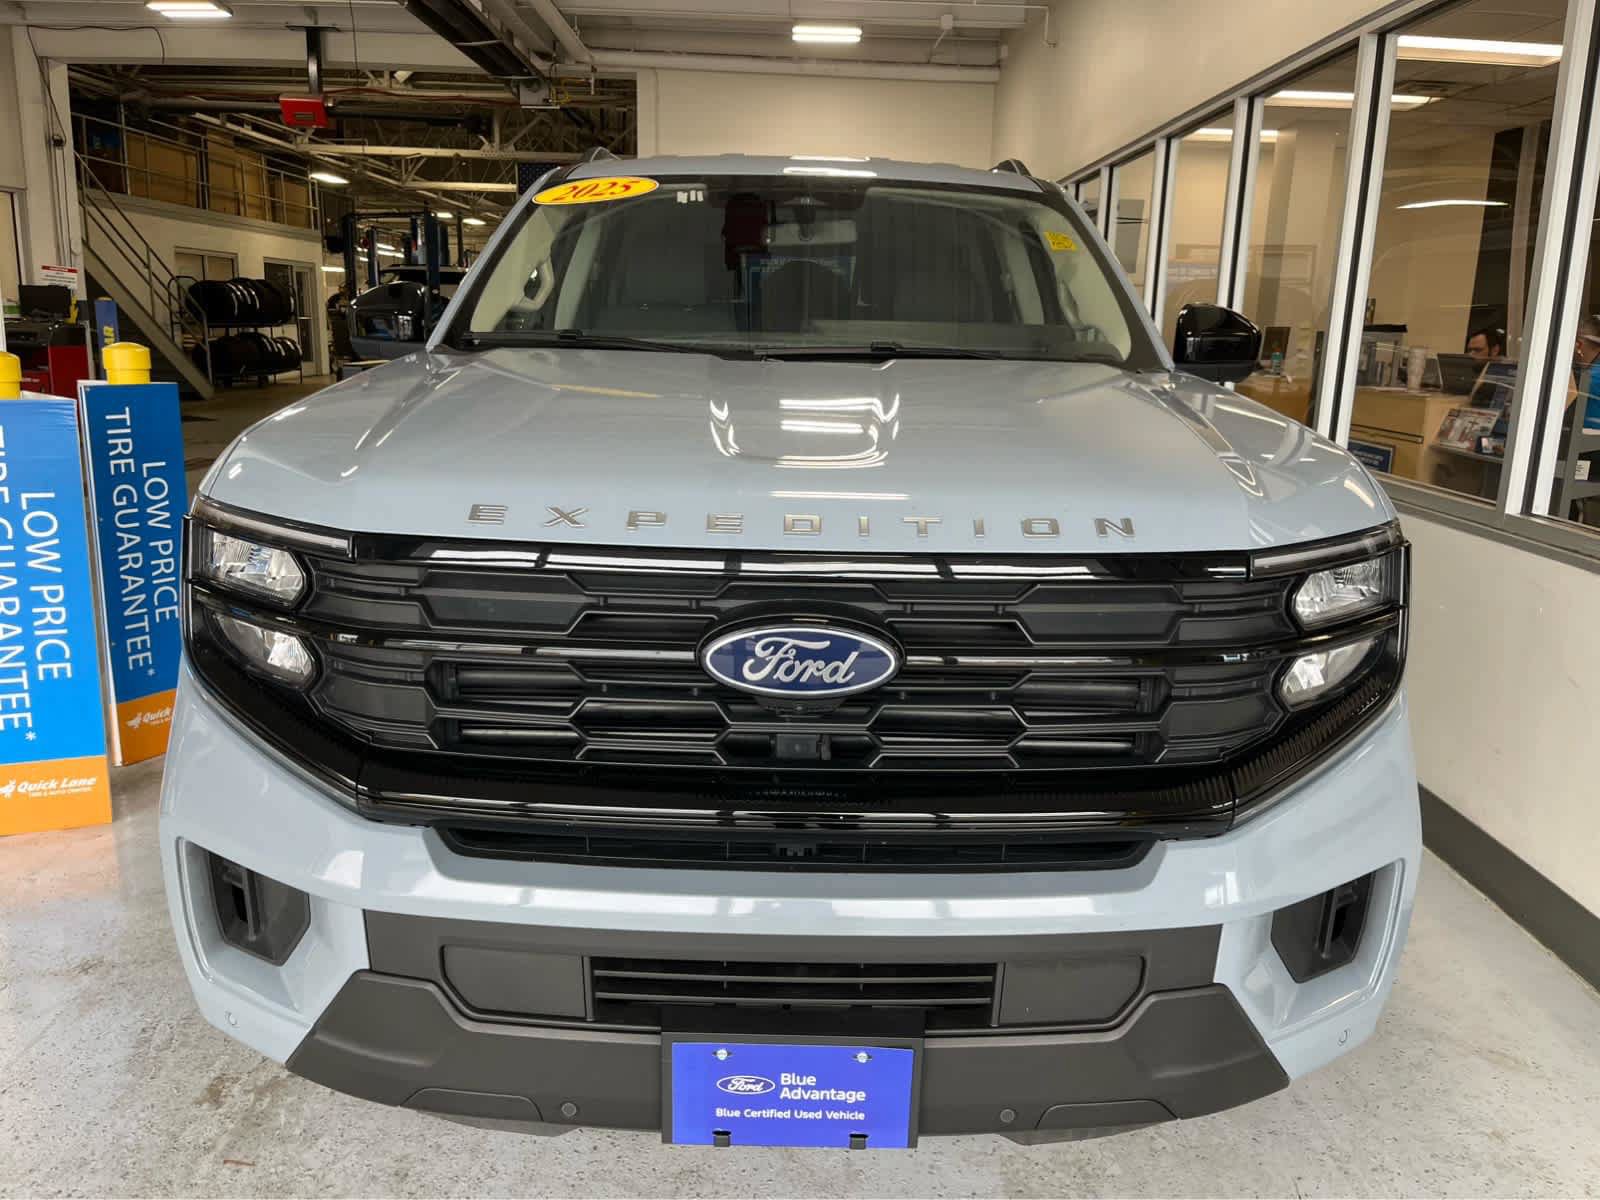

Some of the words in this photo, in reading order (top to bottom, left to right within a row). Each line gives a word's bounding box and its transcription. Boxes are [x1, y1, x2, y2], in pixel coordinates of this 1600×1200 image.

[552, 180, 641, 201] 2025
[105, 406, 136, 476] TIRE
[142, 461, 172, 529] LOW
[20, 492, 63, 573] LOW
[467, 503, 1136, 538] EXPEDITION
[149, 539, 180, 623] PRICE
[30, 585, 73, 681] PRICE
[742, 637, 859, 684] Ford
[17, 780, 58, 793] Quick
[61, 776, 97, 789] Lane
[727, 1077, 765, 1093] Ford
[779, 1087, 867, 1104] Advantage
[780, 1072, 817, 1087] Blue
[715, 1107, 741, 1118] Blue
[743, 1108, 791, 1120] Certified
[794, 1110, 823, 1120] Used
[826, 1110, 866, 1121] Vehicle
